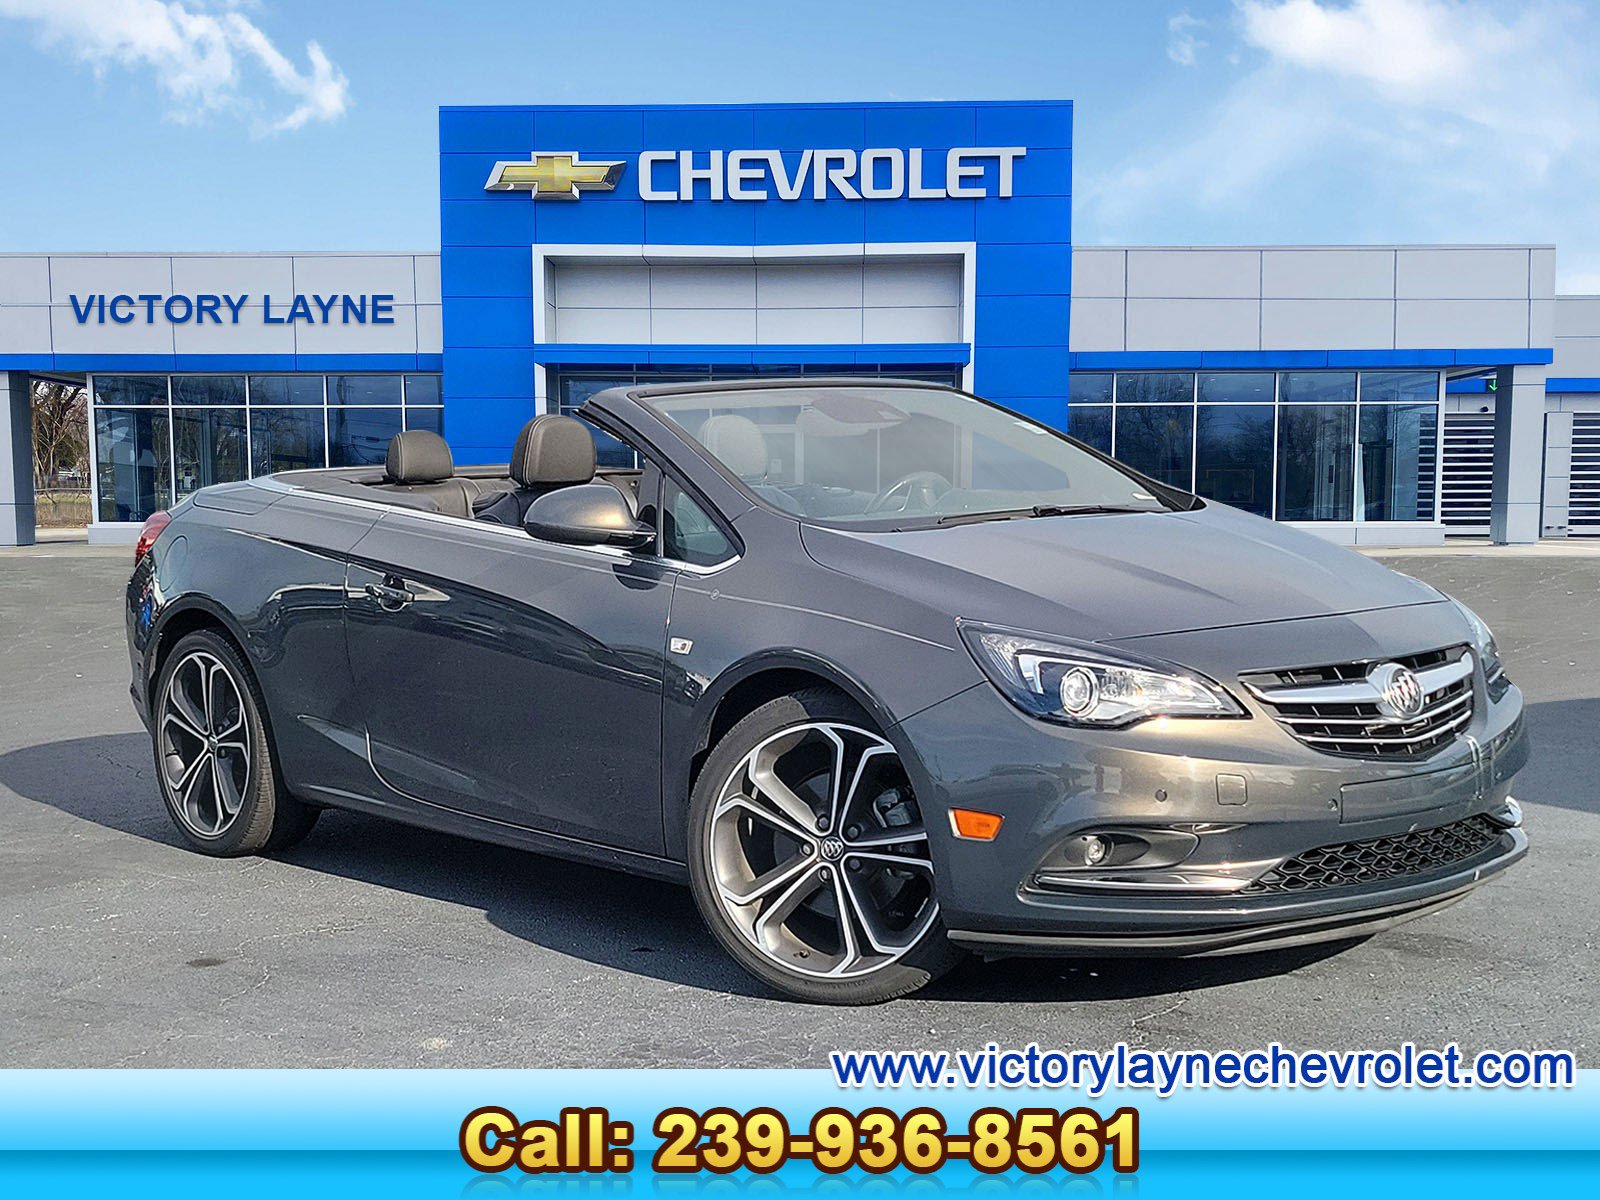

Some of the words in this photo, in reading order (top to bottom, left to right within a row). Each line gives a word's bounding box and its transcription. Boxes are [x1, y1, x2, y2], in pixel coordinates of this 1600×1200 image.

[638, 147, 1026, 201] CHEVROLET
[69, 294, 249, 325] VICTORY
[263, 294, 395, 325] LAYNE
